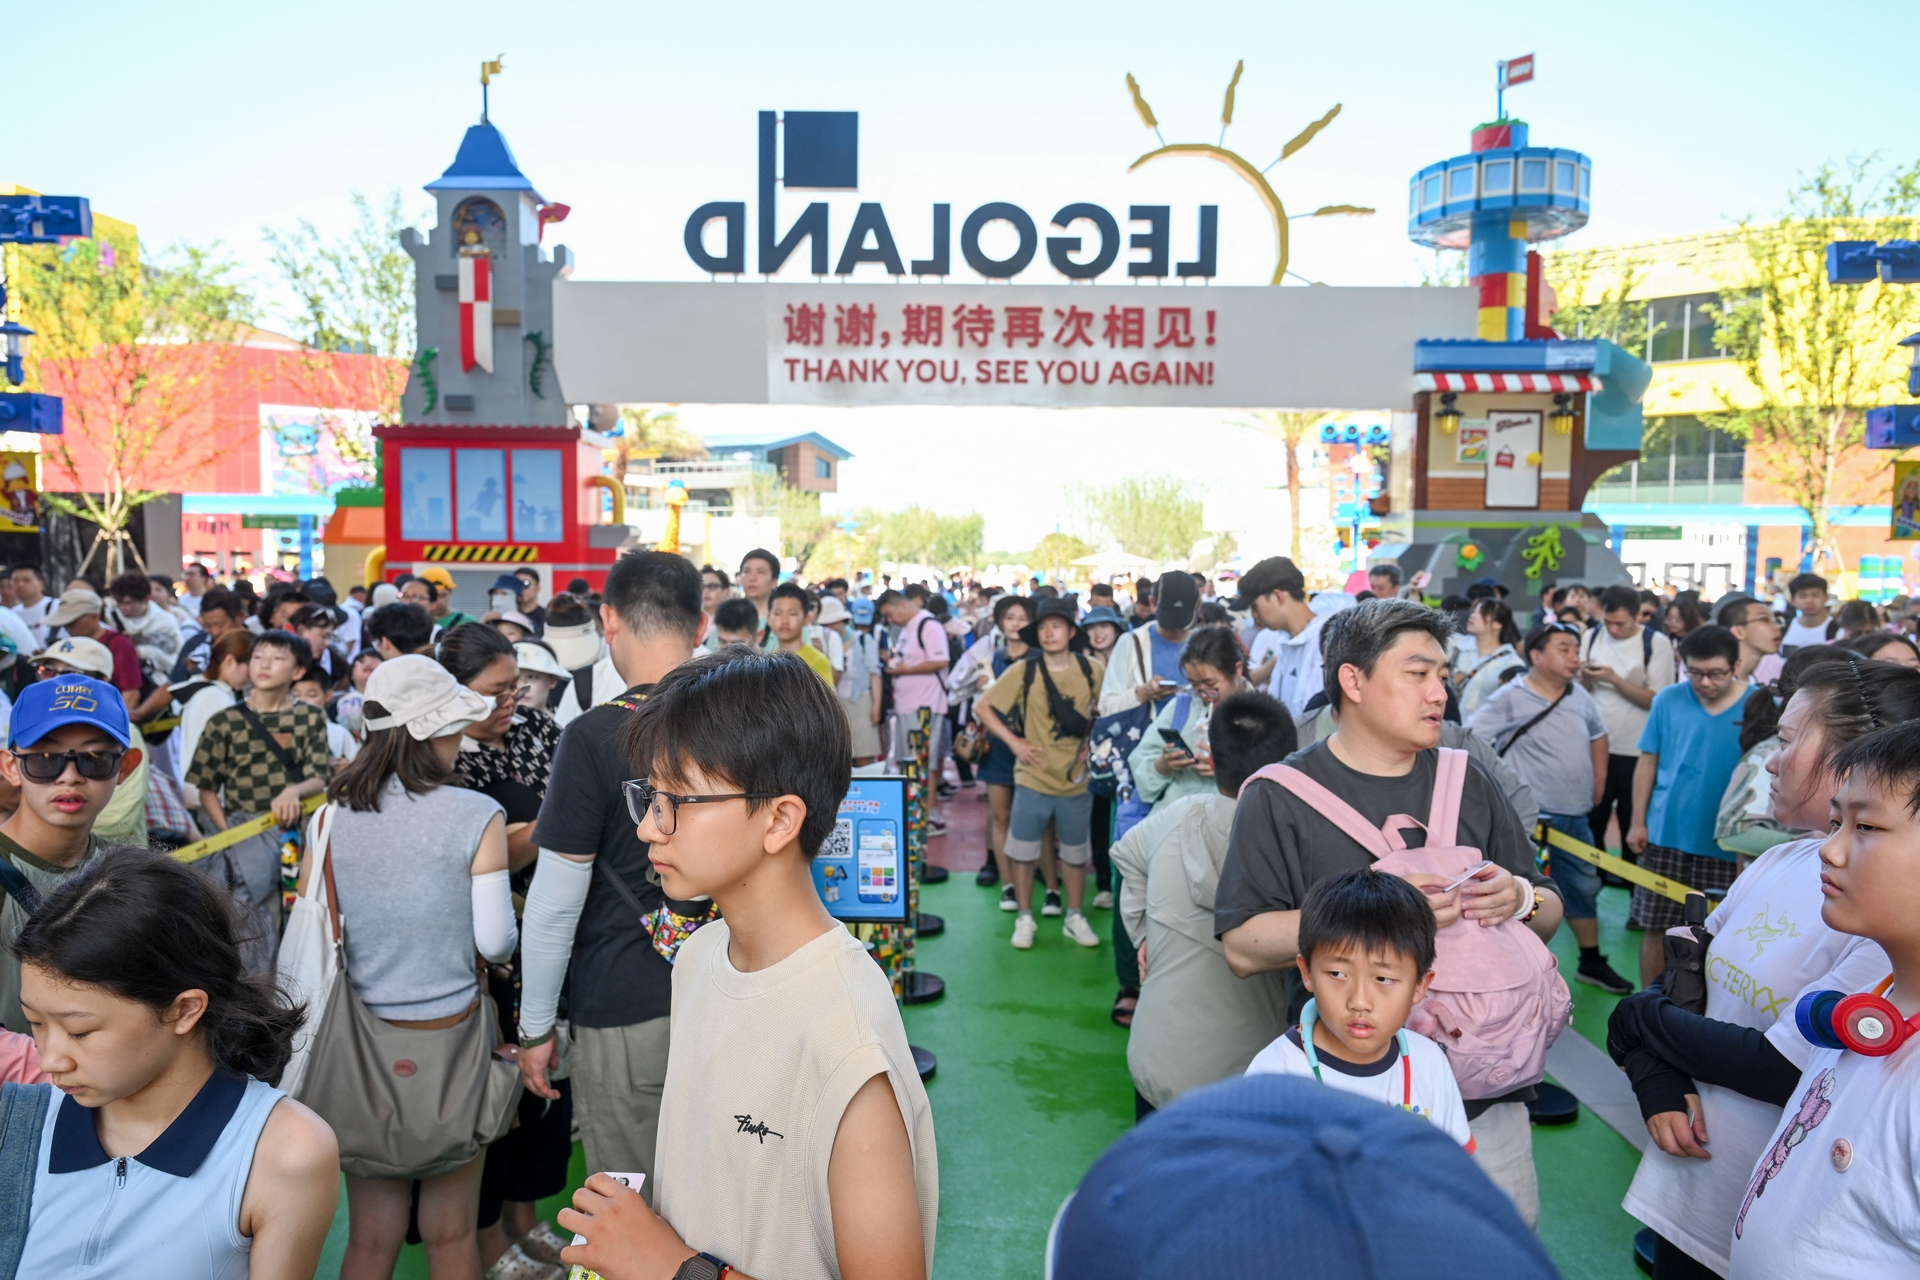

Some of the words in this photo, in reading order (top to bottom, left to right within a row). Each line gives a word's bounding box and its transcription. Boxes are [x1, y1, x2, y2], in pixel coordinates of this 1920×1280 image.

[784, 358, 889, 383] THANK
[896, 359, 967, 385] YOU,
[975, 359, 1029, 385] SEE
[1036, 360, 1100, 385] YOU
[1108, 361, 1214, 386] AGAIN!
[55, 685, 94, 696] CURRY
